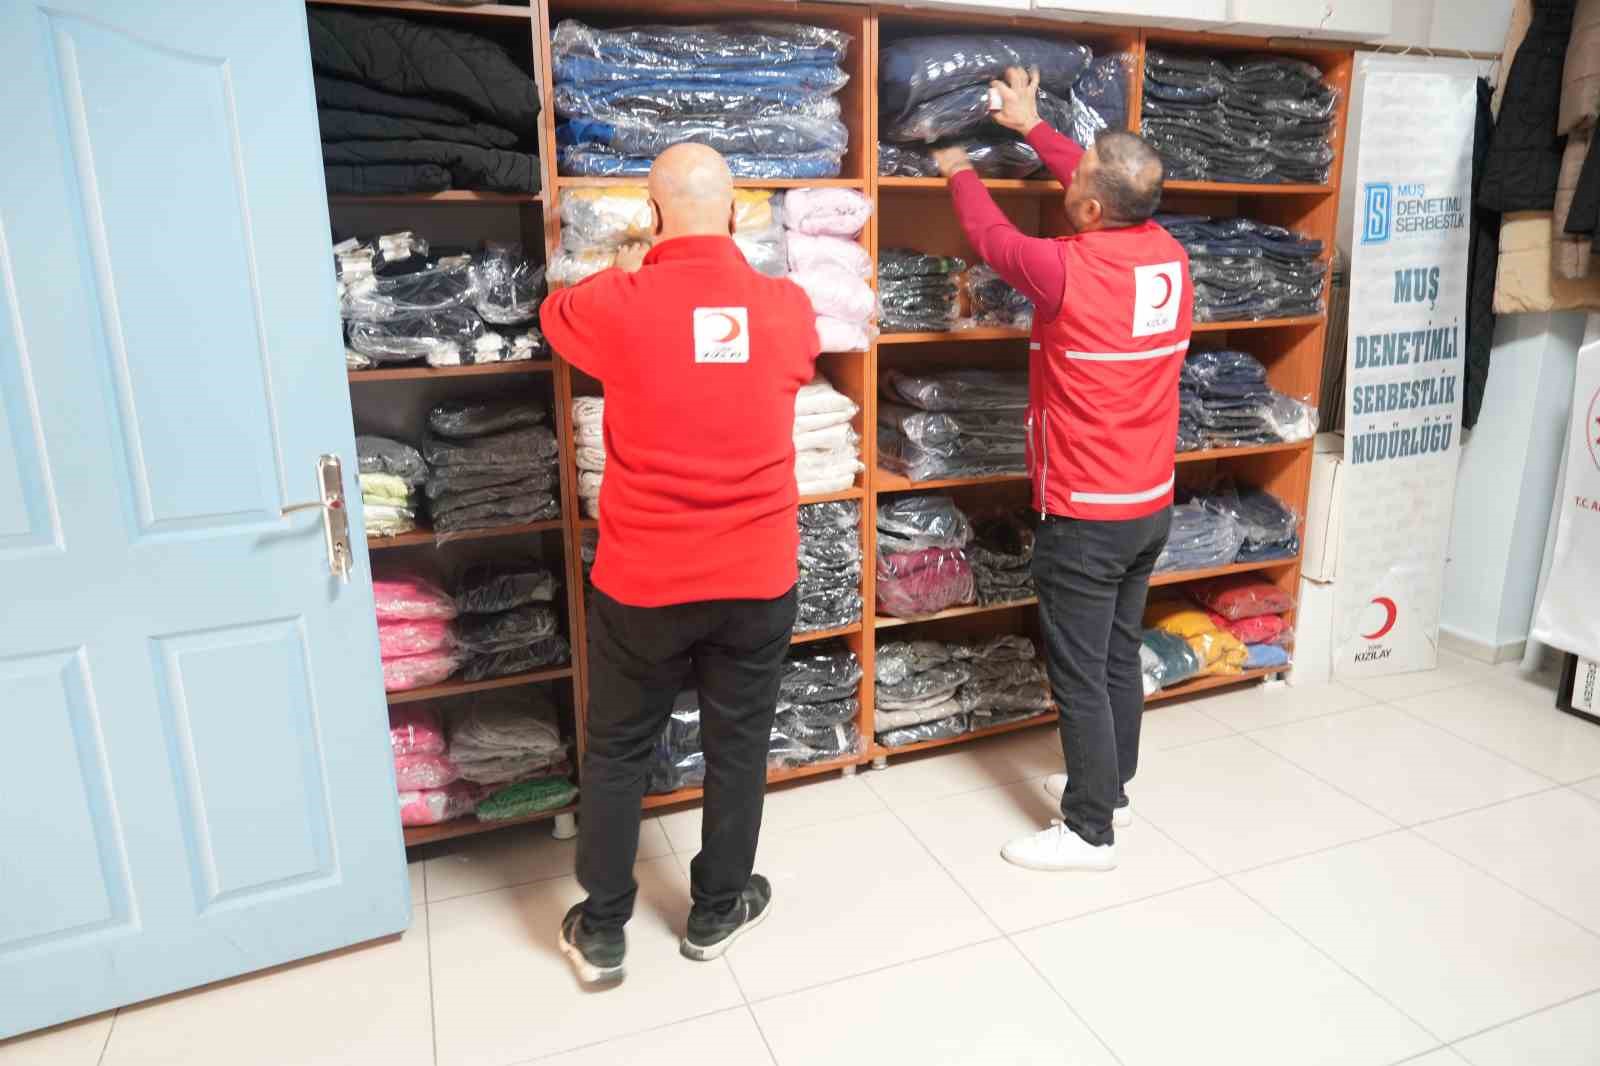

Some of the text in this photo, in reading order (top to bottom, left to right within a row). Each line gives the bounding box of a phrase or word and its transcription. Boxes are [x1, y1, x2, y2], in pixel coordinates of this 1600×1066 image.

[1393, 267, 1440, 311] MUŞ
[1354, 316, 1458, 369] DENETİMLİ
[1352, 368, 1456, 415] SERBESTLİK
[1351, 414, 1453, 465] MÜDÜRLÜĞÜ
